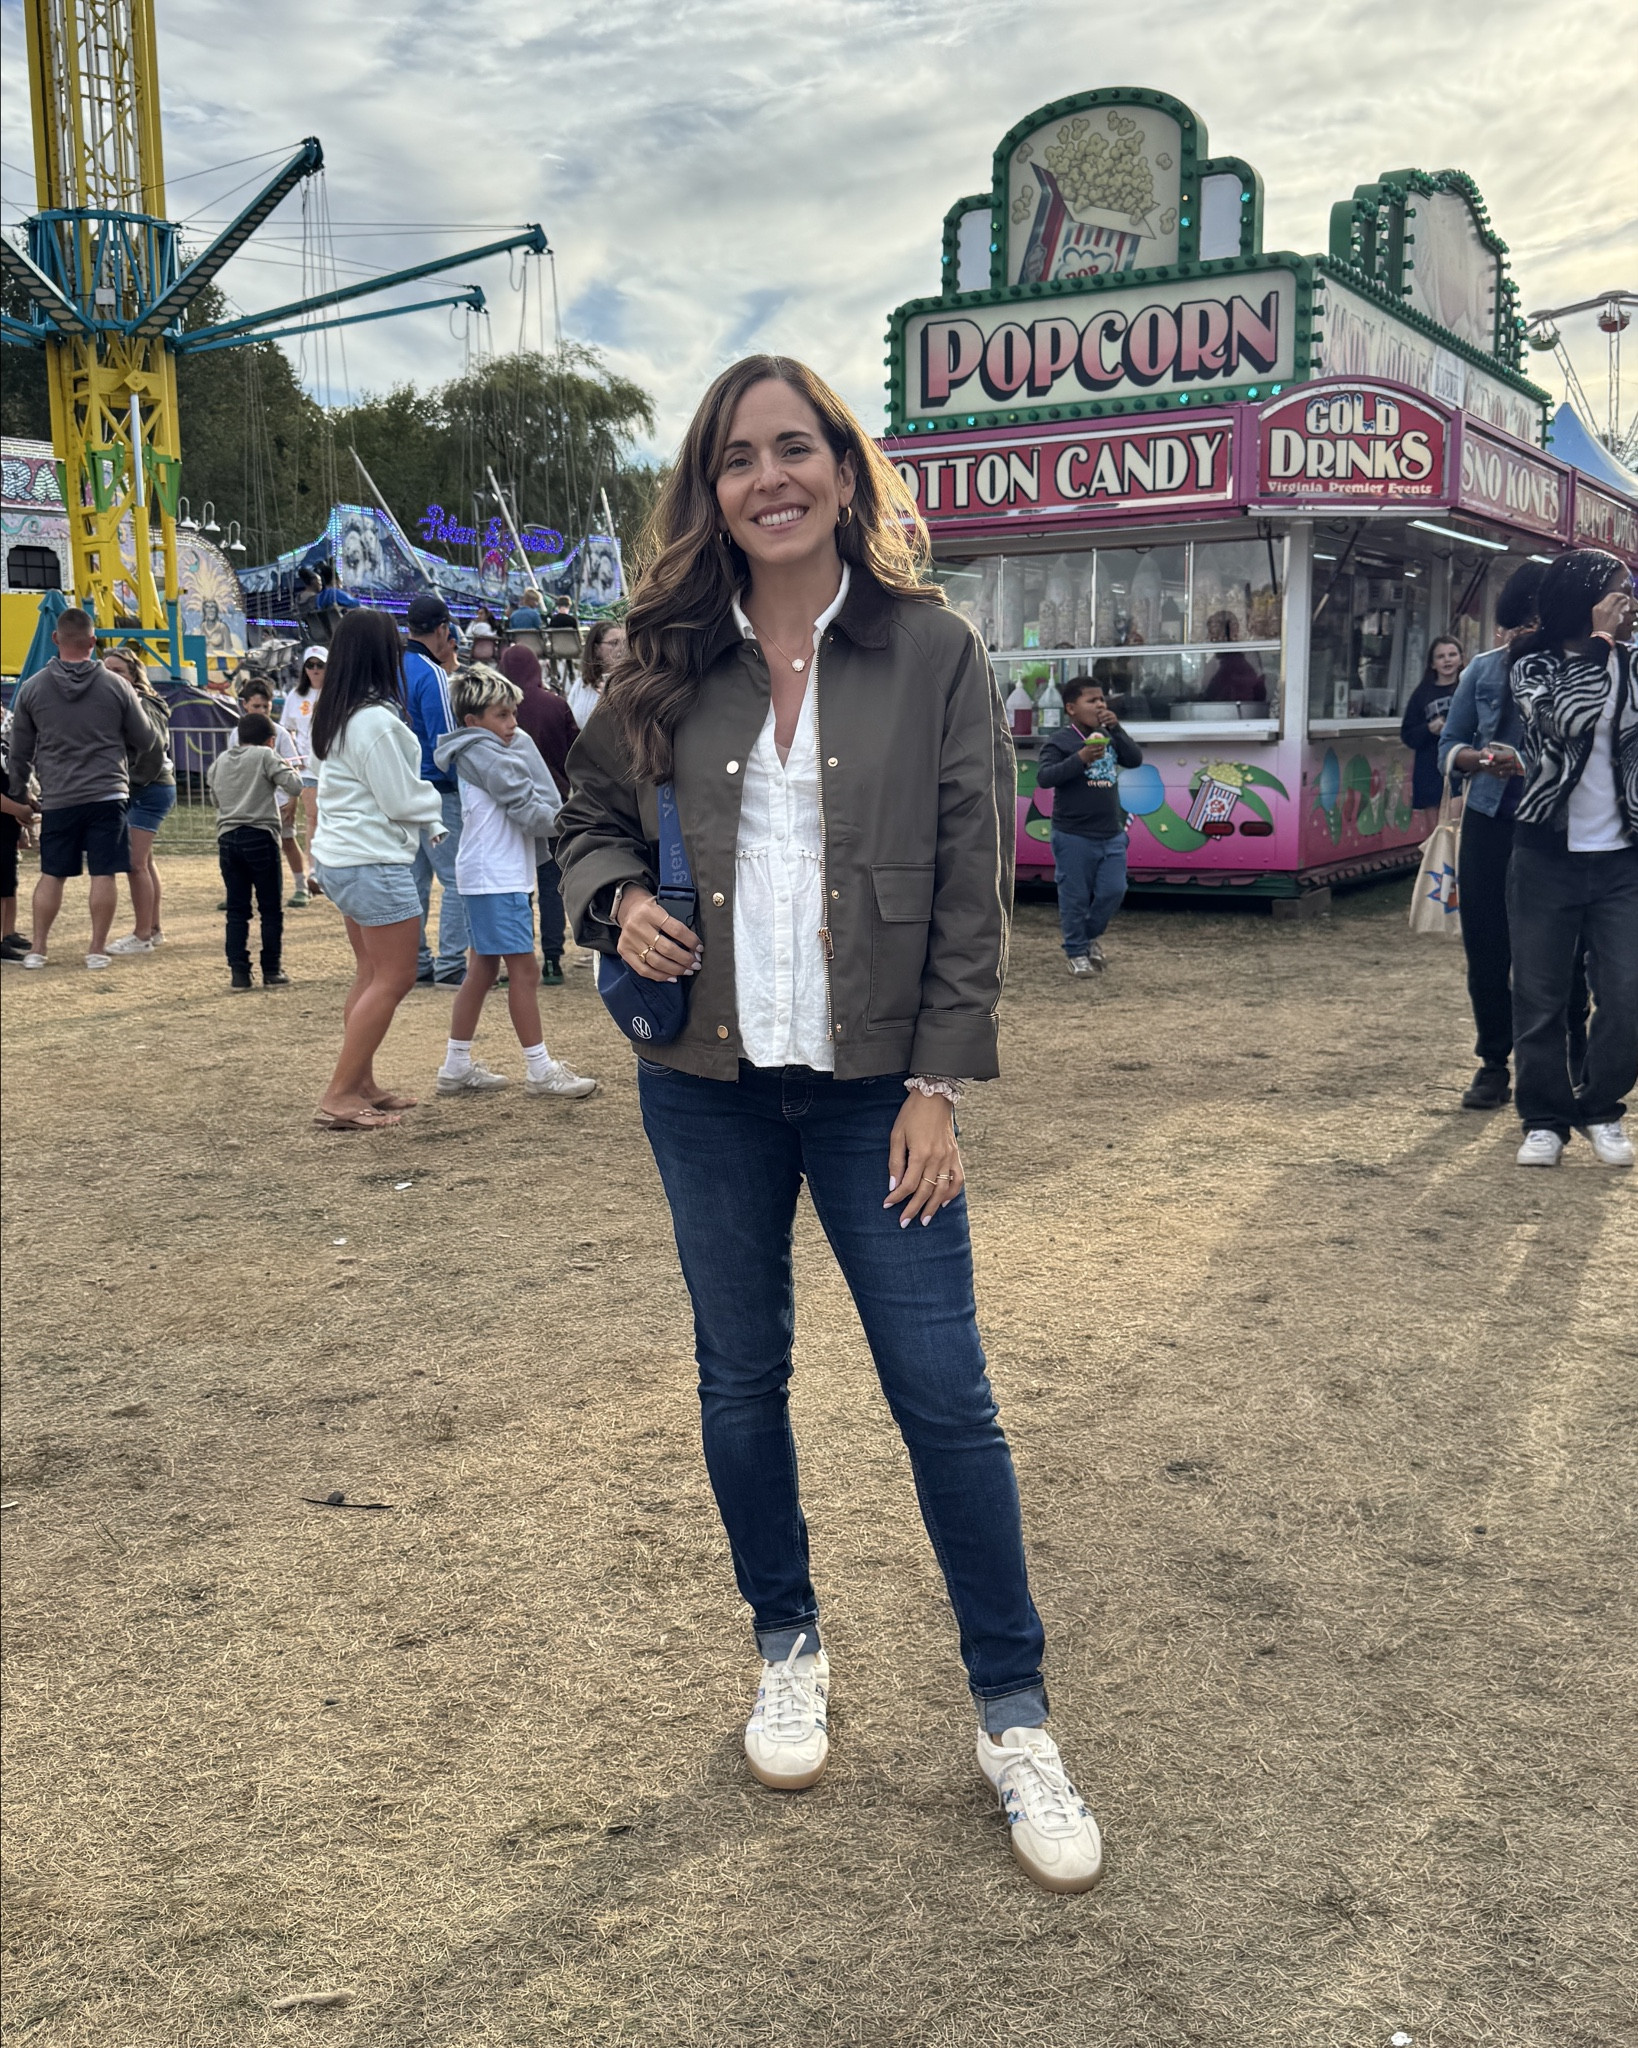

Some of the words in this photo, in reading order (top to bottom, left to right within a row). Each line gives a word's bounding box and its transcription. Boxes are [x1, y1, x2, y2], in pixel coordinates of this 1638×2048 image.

[920, 291, 1280, 409] POPCORN
[1305, 393, 1400, 437] COLD
[894, 448, 1040, 511] OTTON
[1054, 431, 1224, 500] CANDY
[1268, 427, 1433, 480] DRINKS
[1461, 440, 1502, 502] SNO
[1505, 461, 1560, 524] KONES
[1267, 481, 1323, 495] Virginia
[1329, 481, 1384, 494] Premier
[1388, 482, 1433, 495] Events
